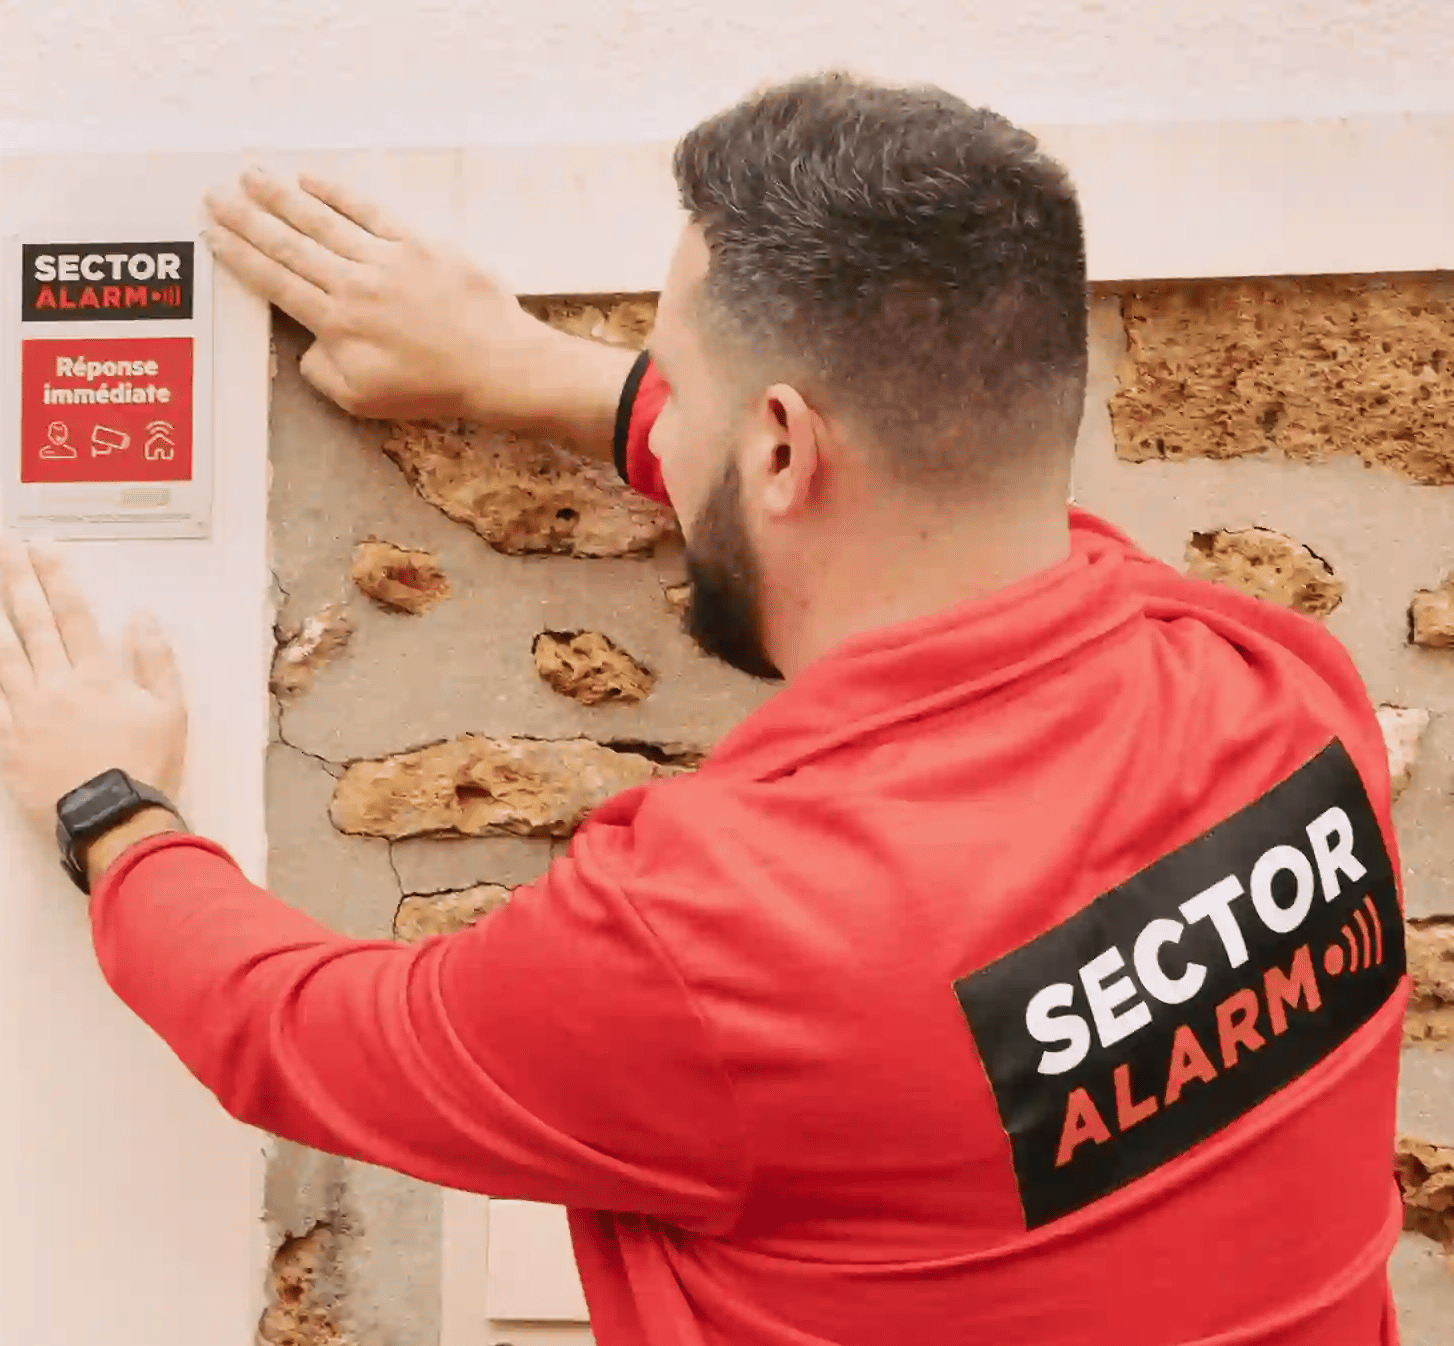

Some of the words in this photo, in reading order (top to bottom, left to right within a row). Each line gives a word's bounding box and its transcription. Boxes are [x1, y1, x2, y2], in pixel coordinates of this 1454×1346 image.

[34, 253, 181, 281] SECTOR
[36, 285, 148, 308] ALARM
[56, 356, 158, 381] Réponse
[43, 383, 171, 405] immédiate
[1025, 806, 1368, 1075] SECTOR
[1054, 944, 1322, 1167] ALARM
